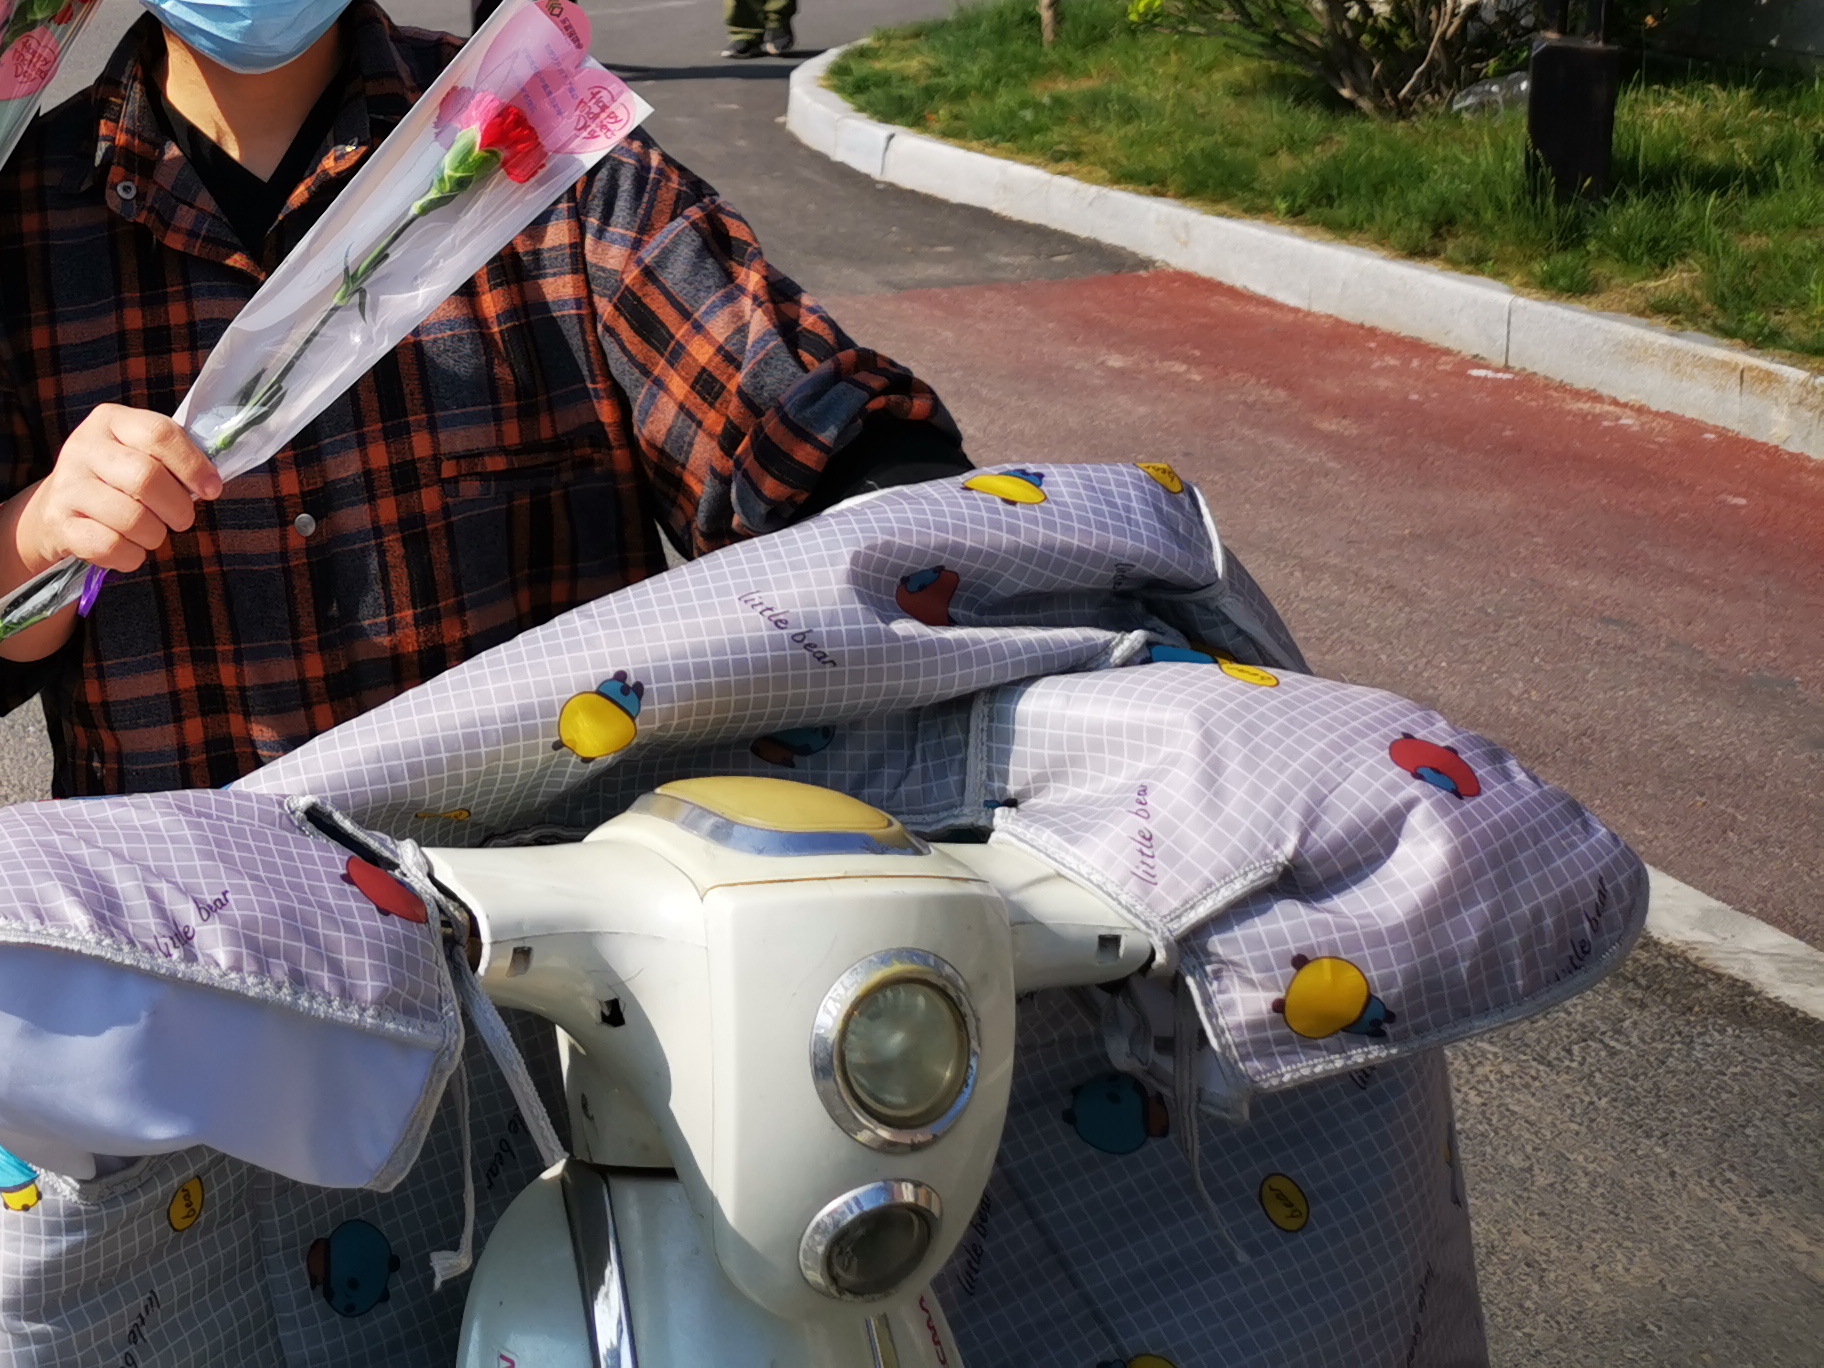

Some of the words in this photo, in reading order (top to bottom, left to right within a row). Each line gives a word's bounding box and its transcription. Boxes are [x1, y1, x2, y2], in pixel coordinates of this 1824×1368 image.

[738, 590, 789, 630] little
[791, 629, 837, 667] bear
[1126, 826, 1158, 886] little
[486, 1138, 516, 1190] bear
[181, 1188, 196, 1220] bear
[956, 1243, 984, 1296] little
[128, 1289, 161, 1345] little
